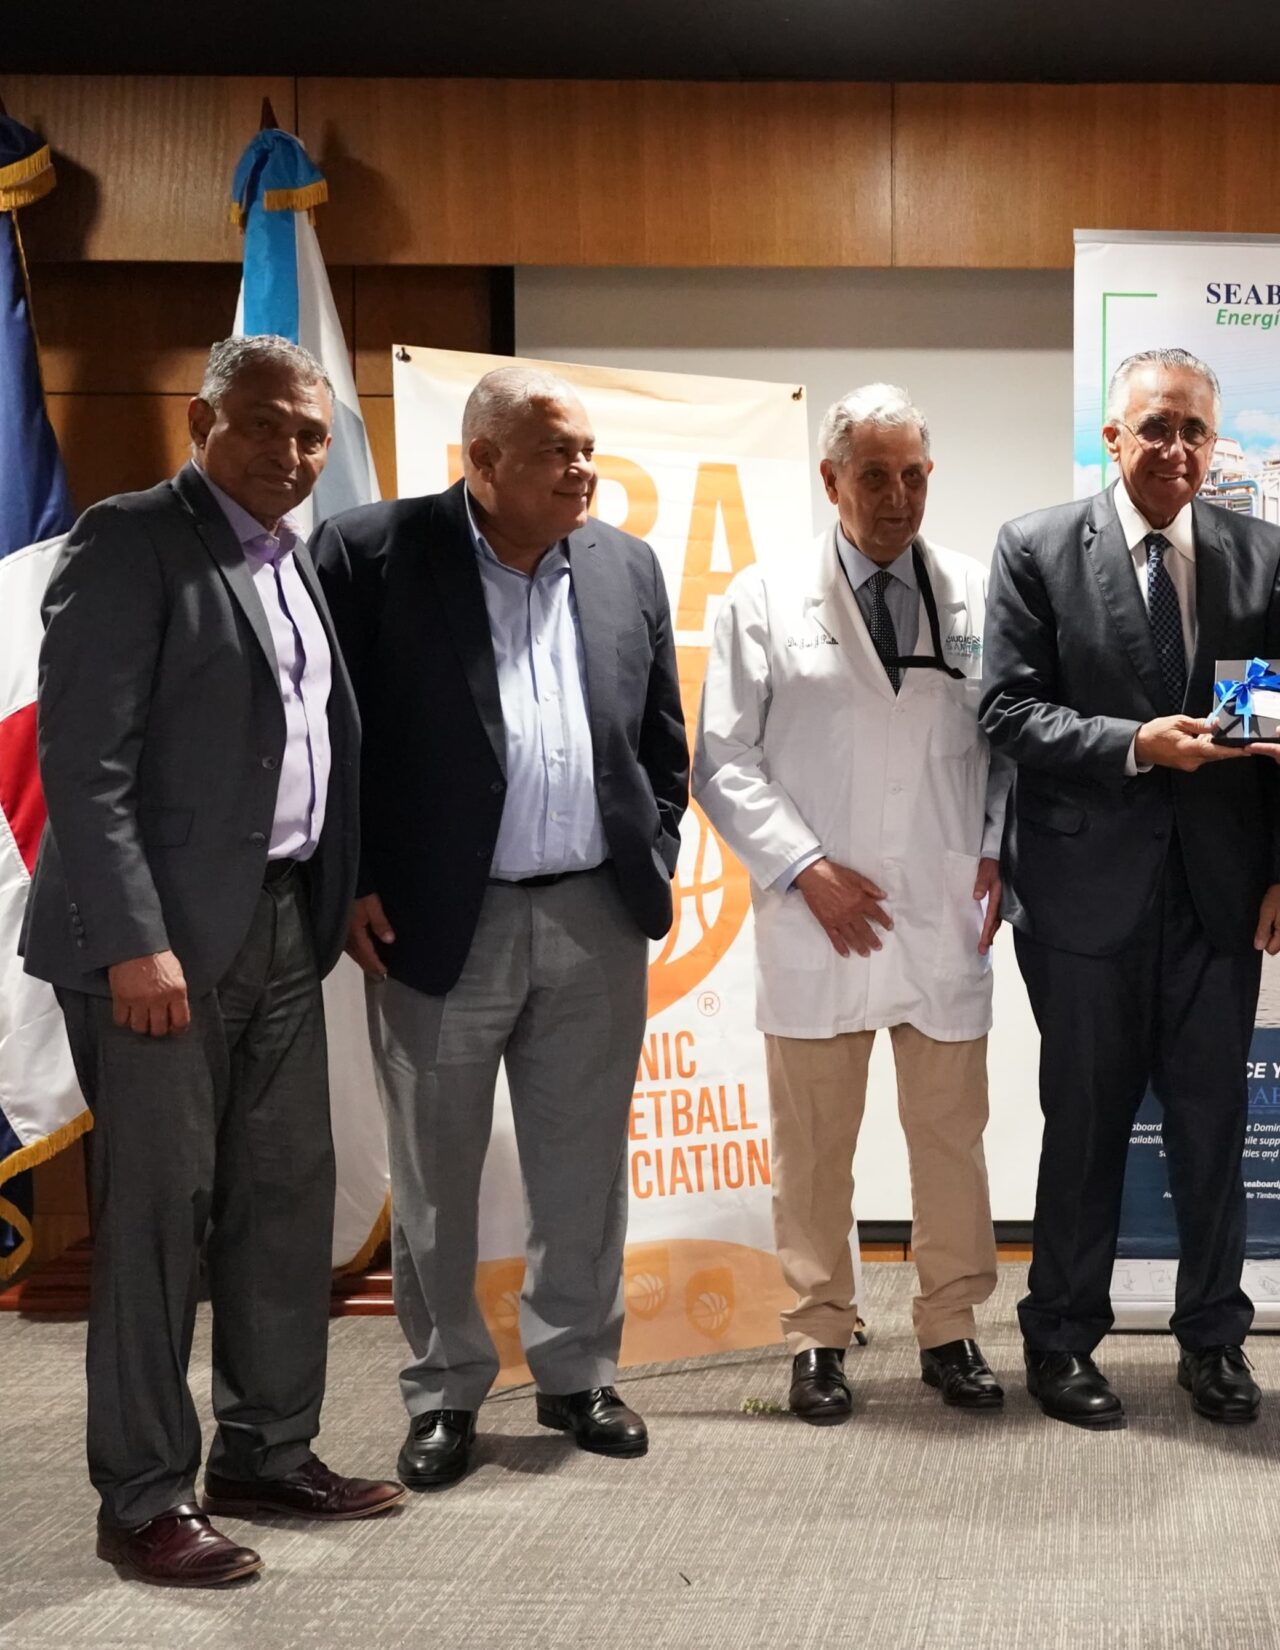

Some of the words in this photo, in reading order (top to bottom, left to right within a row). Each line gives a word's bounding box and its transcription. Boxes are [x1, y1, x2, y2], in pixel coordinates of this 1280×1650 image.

[629, 1084, 758, 1141] ETBALL
[631, 1138, 772, 1199] CIATION
[1261, 1150, 1279, 1158] and
